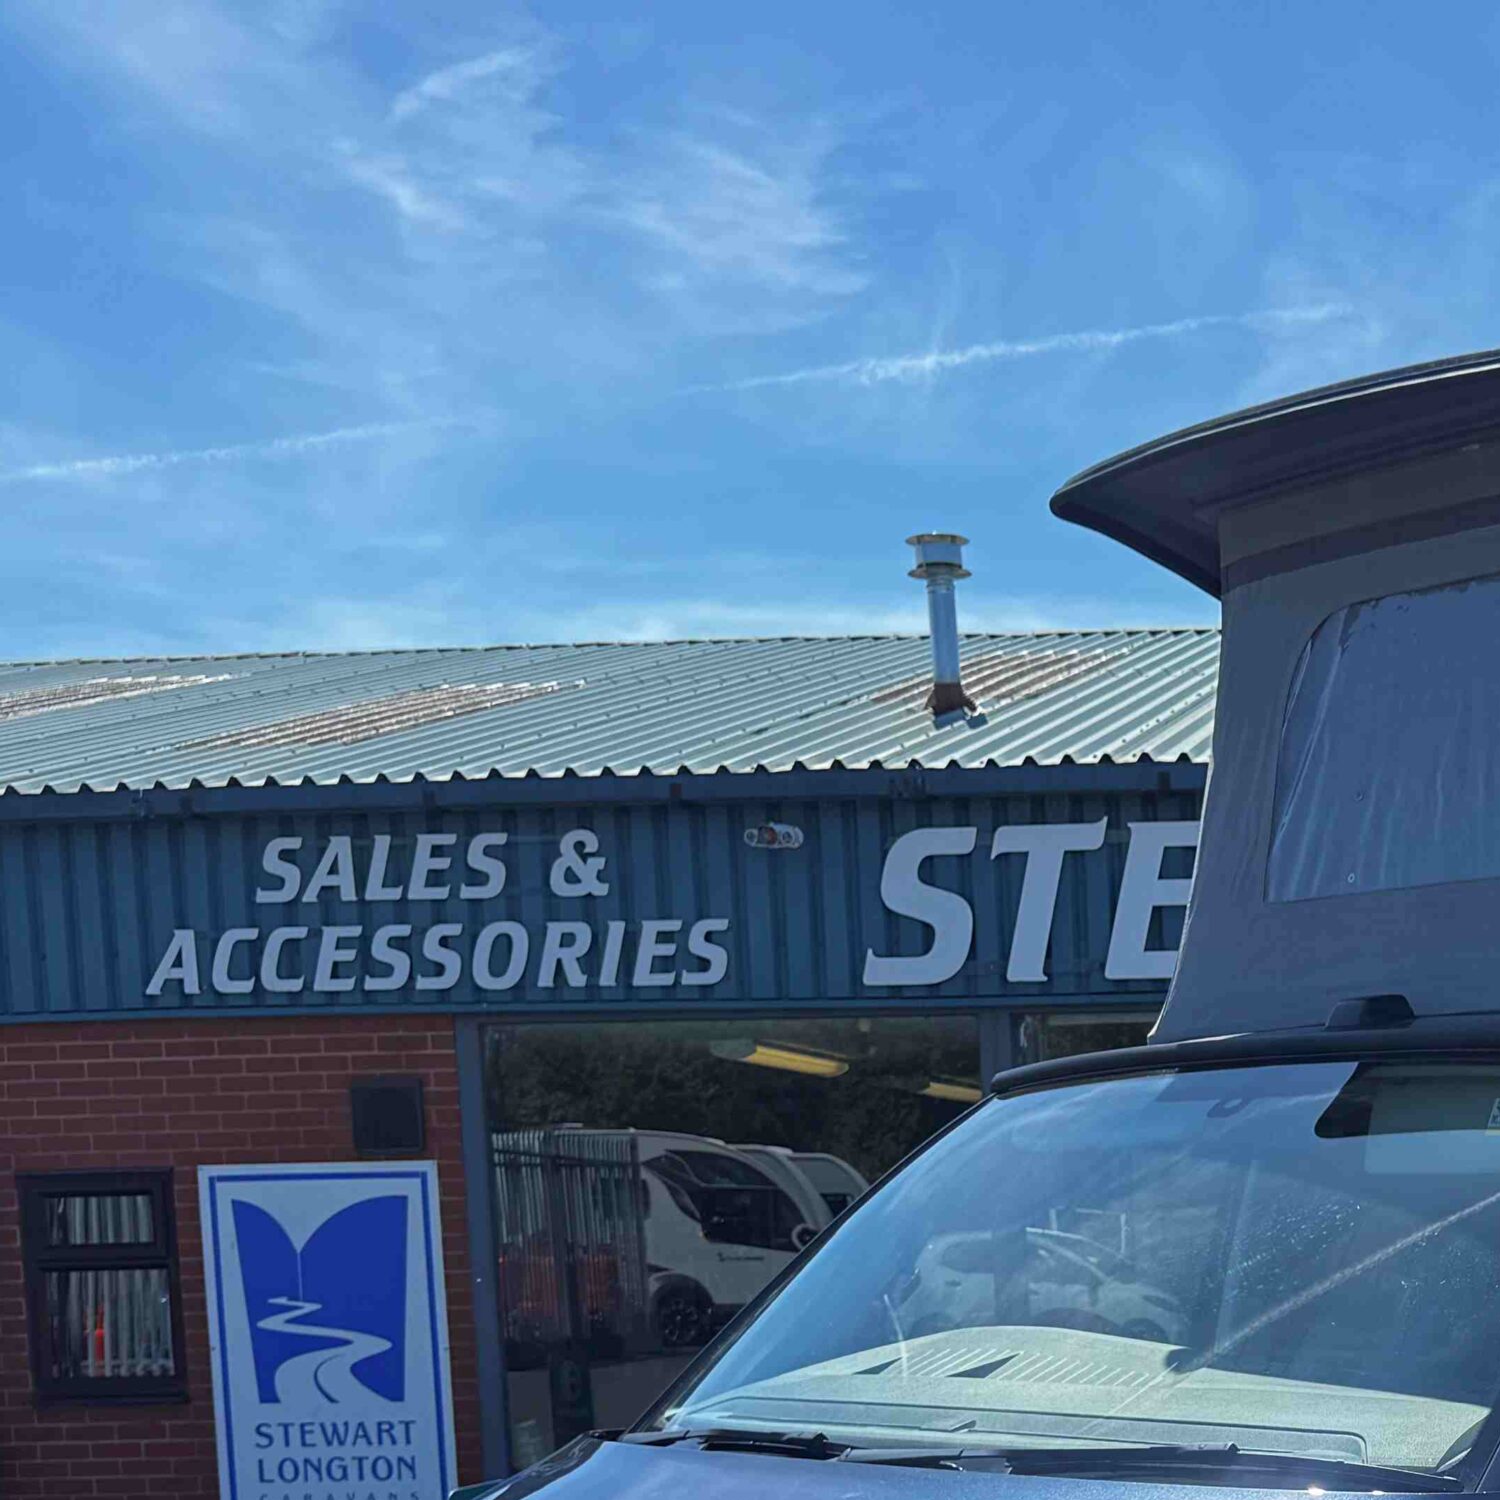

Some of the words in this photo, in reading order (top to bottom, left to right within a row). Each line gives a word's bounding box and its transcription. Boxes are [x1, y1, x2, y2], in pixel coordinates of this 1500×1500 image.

[255, 830, 509, 905] SALES
[549, 828, 610, 898] &
[145, 917, 732, 996] ACCESSORIES
[254, 1420, 417, 1449] STEWART
[257, 1455, 417, 1483] LONGTON
